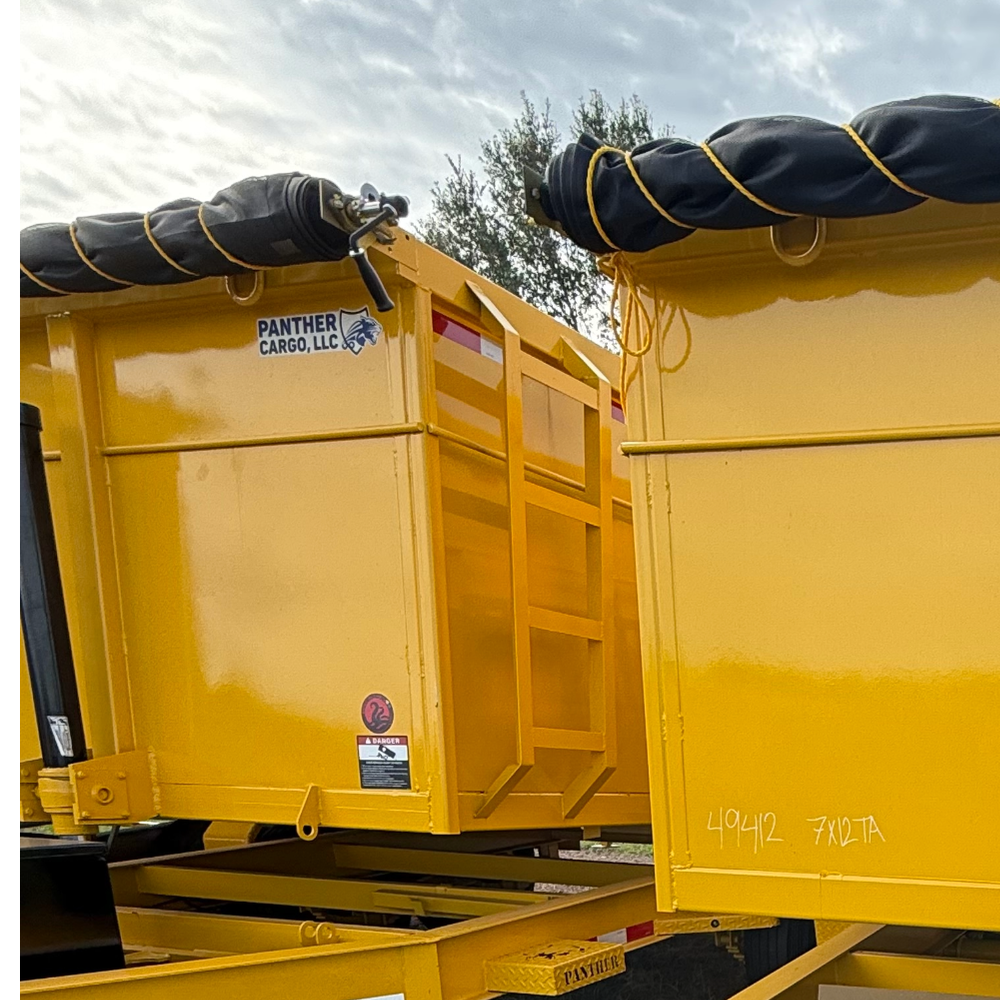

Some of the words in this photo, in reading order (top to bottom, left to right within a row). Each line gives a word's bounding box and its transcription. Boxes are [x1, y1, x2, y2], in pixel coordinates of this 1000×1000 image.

[258, 313, 338, 338] PANTHER
[260, 337, 311, 355] CARGO,
[313, 334, 339, 351] LLC
[707, 807, 785, 854] 49412
[564, 955, 620, 986] PANTHER
